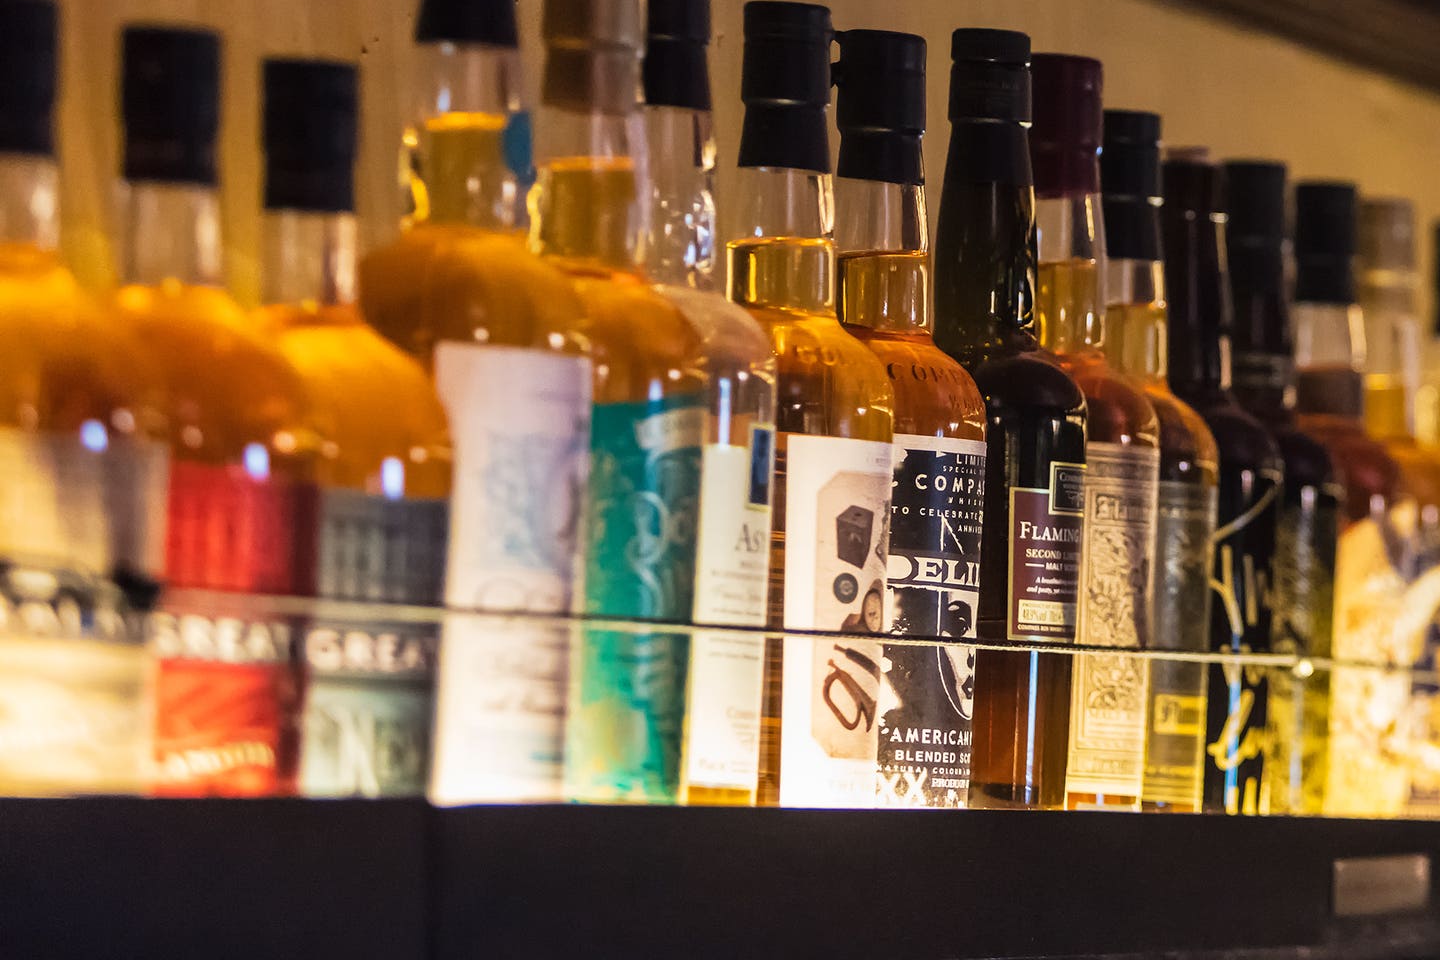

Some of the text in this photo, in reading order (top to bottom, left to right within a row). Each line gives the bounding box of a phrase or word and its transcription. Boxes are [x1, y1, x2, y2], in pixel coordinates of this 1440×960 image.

[891, 506, 910, 515] TO
[1020, 521, 1079, 542] FLAMING
[1025, 548, 1062, 560] SECOND
[895, 750, 956, 764] BLENDED
